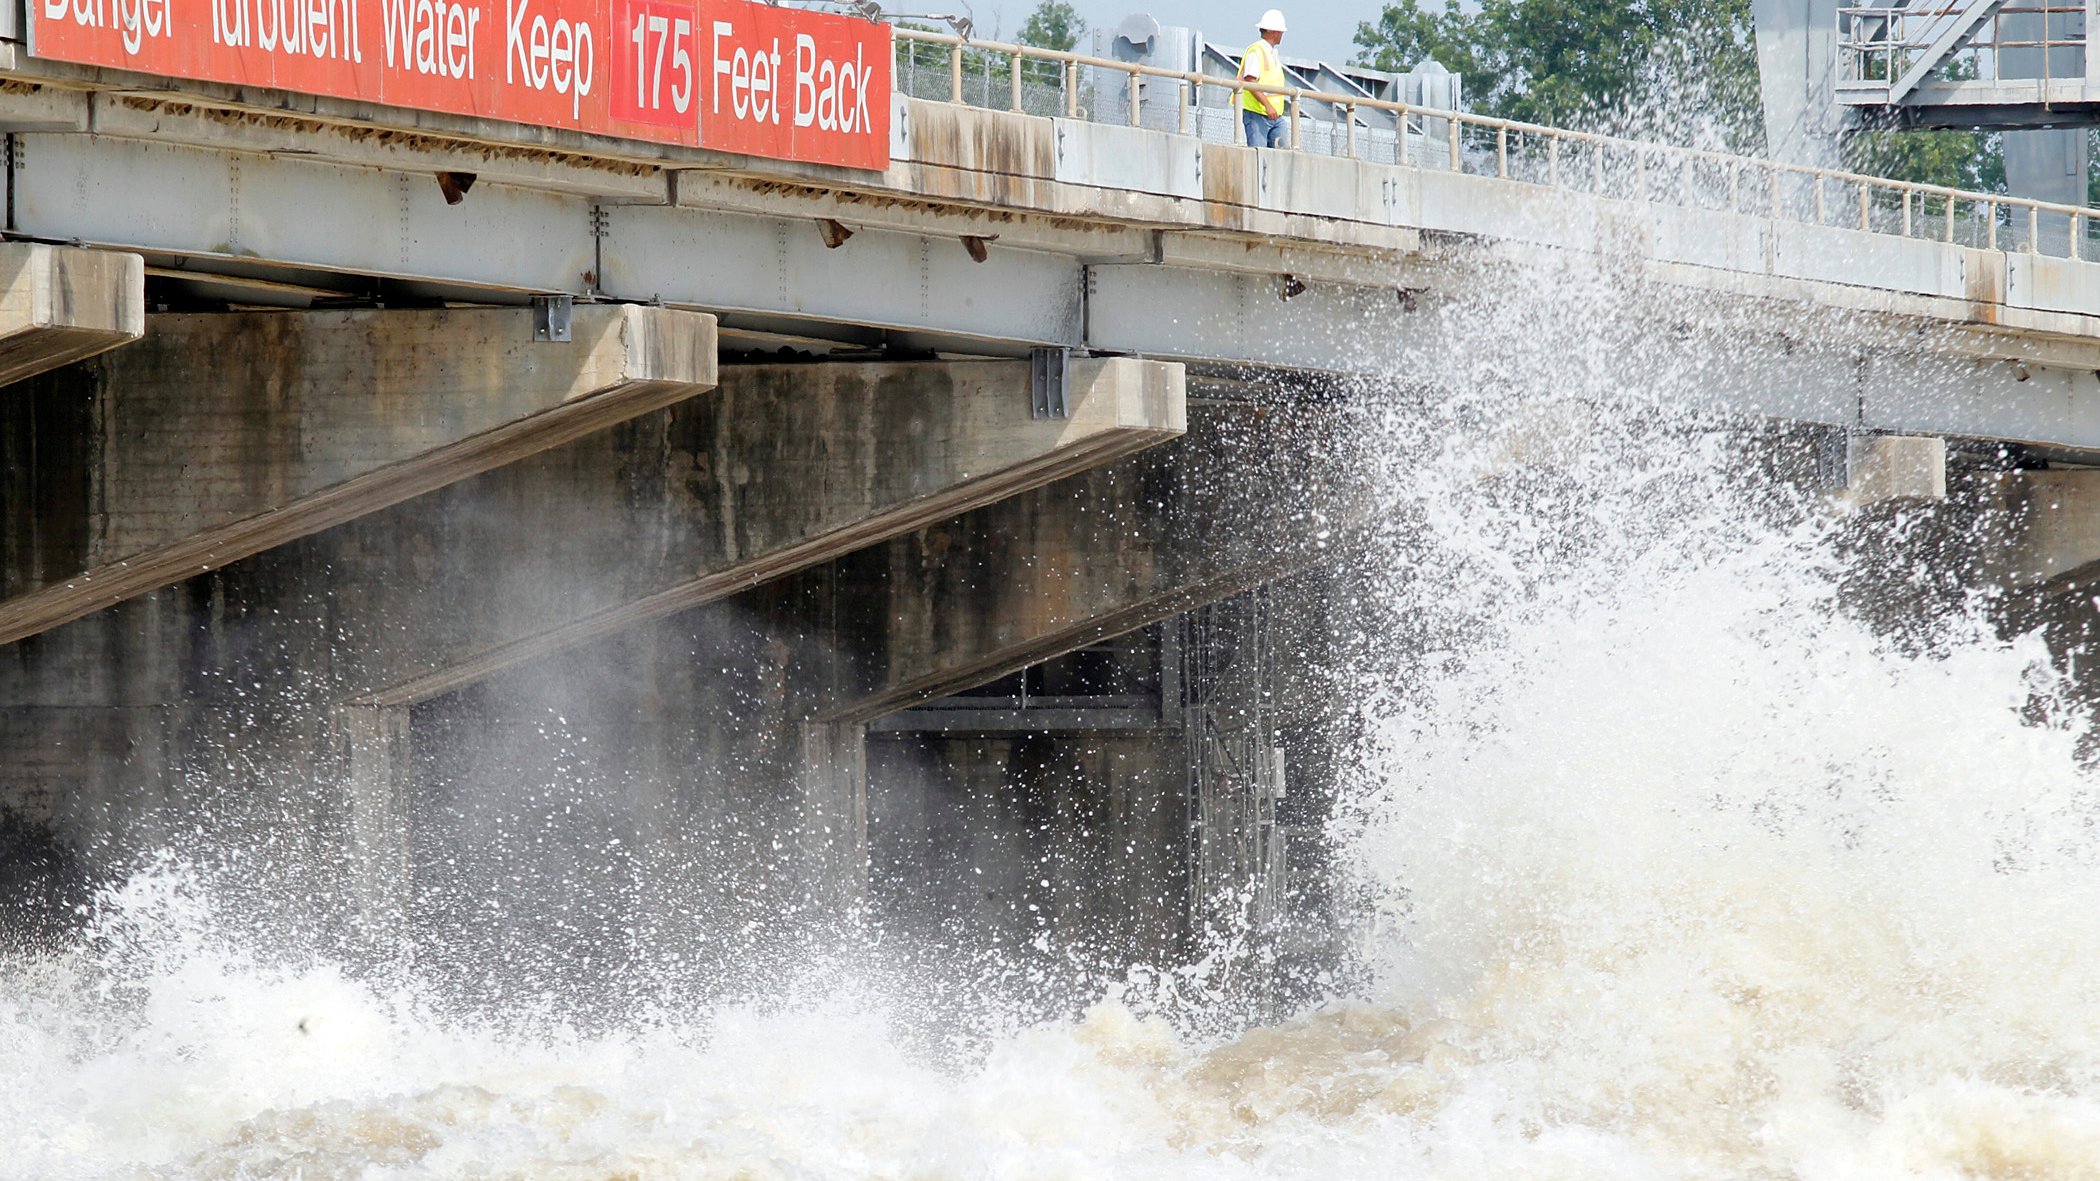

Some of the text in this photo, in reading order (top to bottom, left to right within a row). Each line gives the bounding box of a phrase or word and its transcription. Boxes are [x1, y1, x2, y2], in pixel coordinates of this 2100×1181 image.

[380, 0, 481, 79] Water
[505, 0, 594, 120] Keep
[632, 14, 692, 113] 175
[713, 21, 782, 125] Feet
[795, 33, 872, 134] Back
